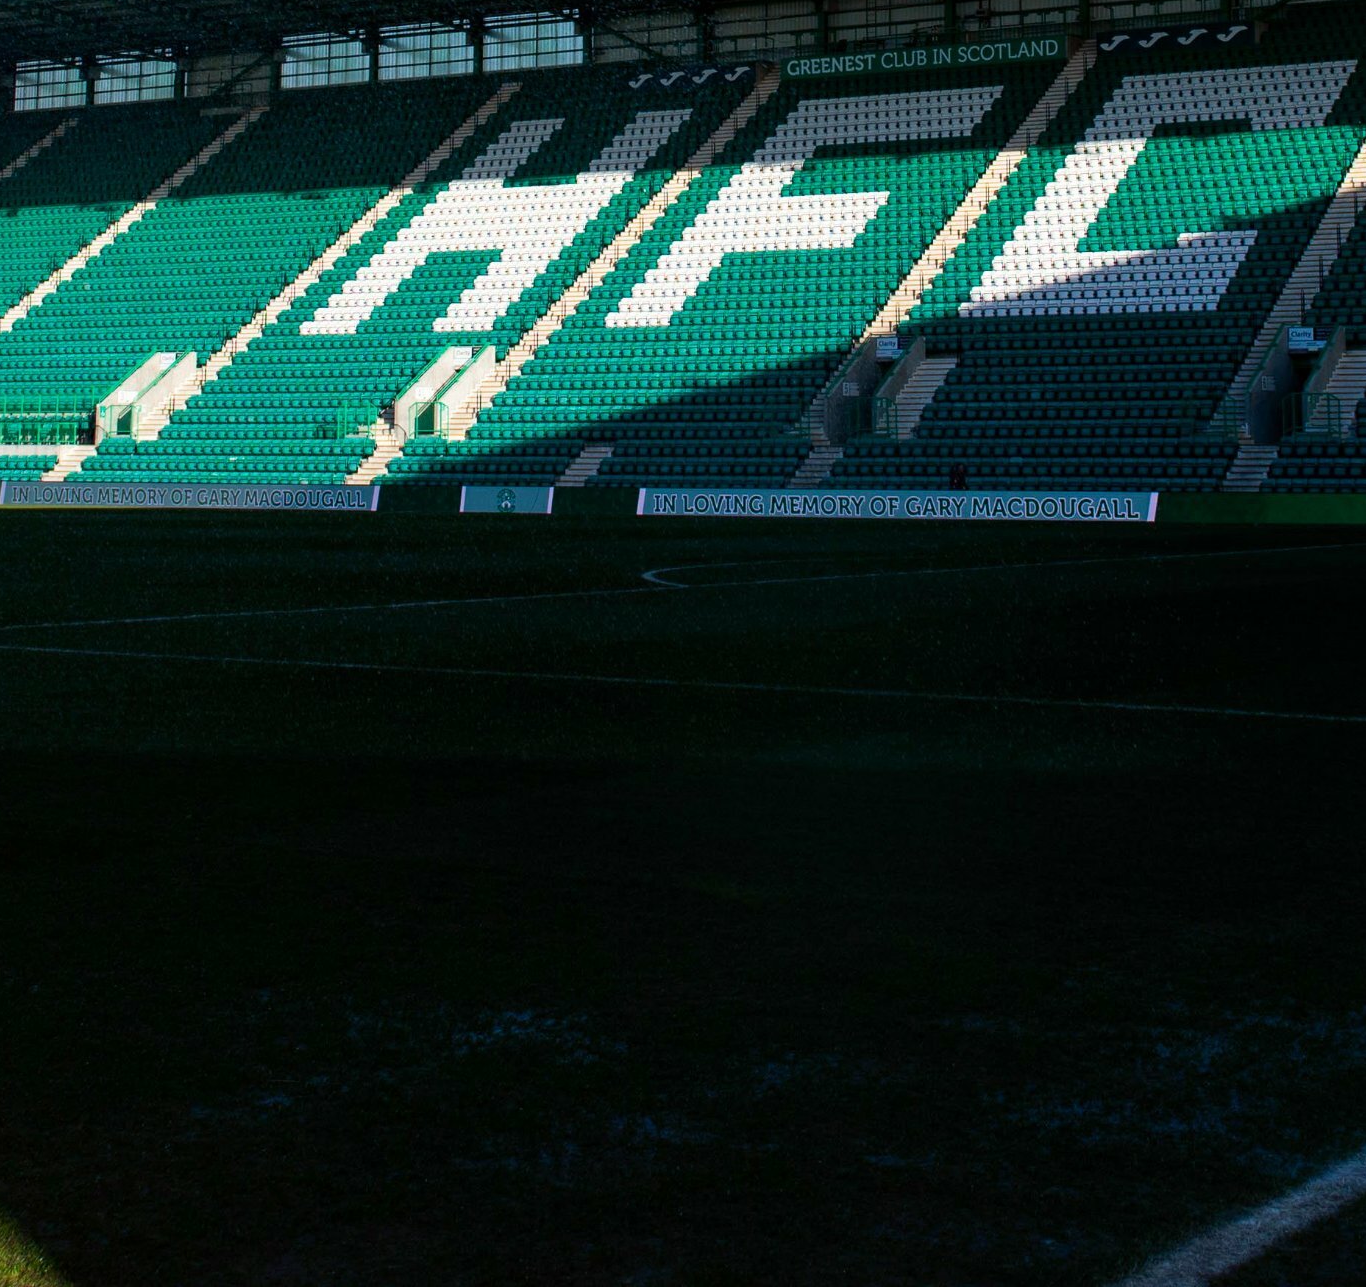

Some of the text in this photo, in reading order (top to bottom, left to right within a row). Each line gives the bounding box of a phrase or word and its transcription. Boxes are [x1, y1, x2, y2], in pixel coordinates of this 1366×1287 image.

[786, 39, 1059, 77] GREENEST CLUB IN SCOTLAND
[1290, 331, 1312, 339] Clarity
[11, 486, 366, 509] IN LOVING MEMORY OF GARY MACDOUGALL
[653, 494, 1141, 520] IN LOVING MEMORY OF GARY MACDOUGALL
